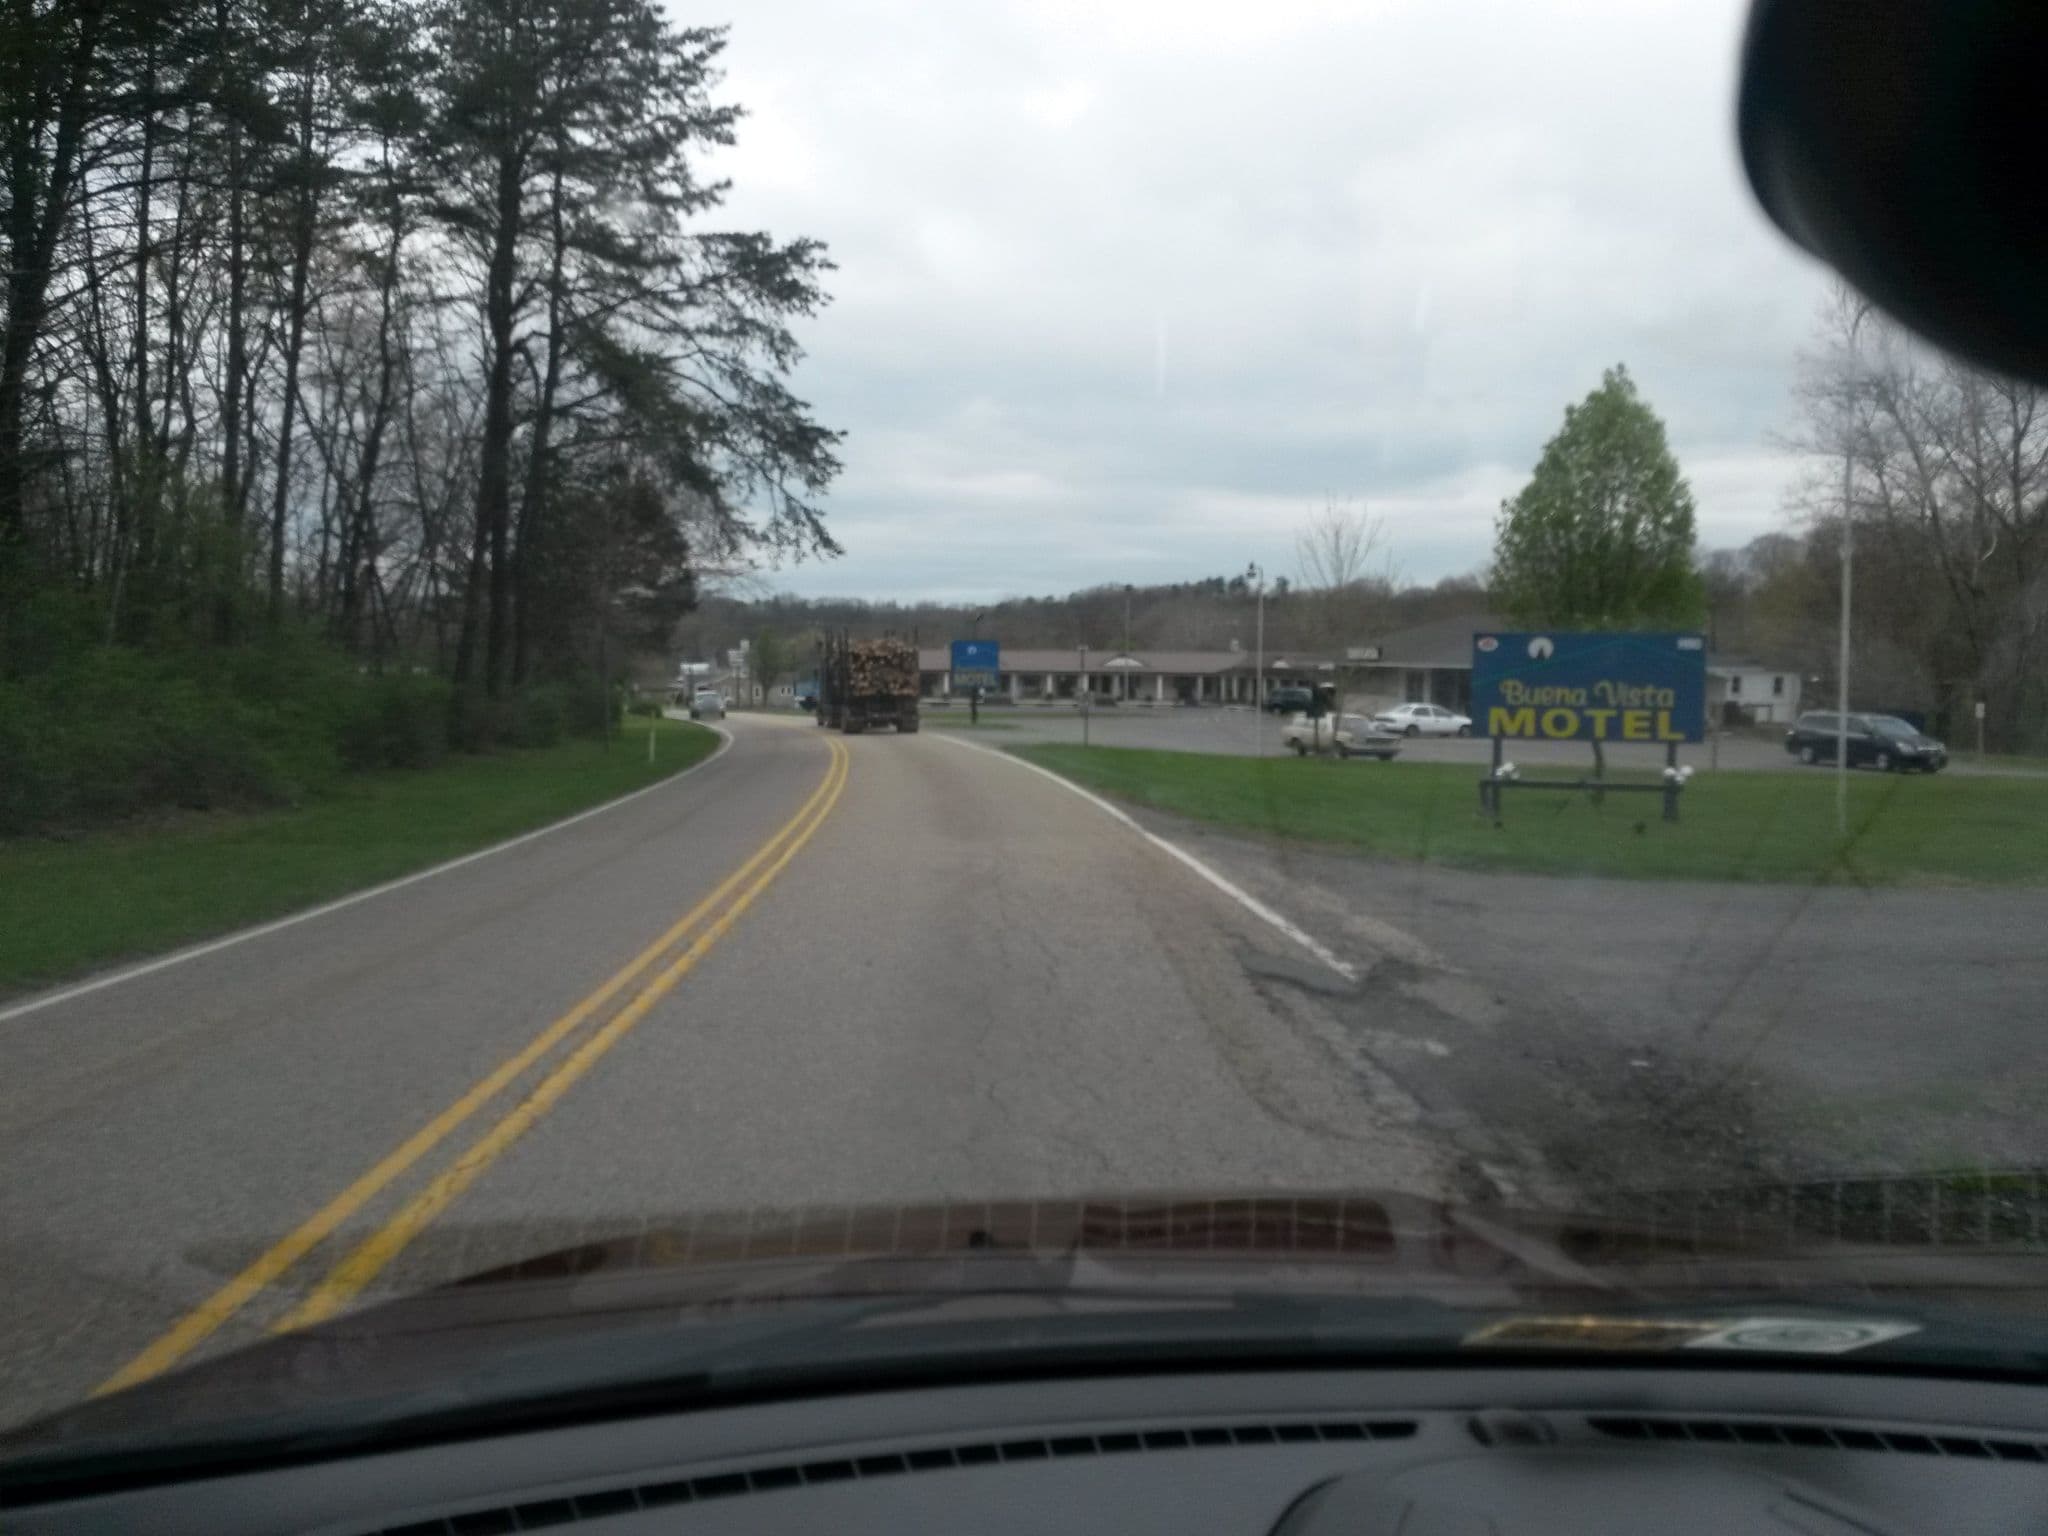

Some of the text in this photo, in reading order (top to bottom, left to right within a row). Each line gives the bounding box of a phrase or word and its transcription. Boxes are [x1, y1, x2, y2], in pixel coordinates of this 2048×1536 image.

[1500, 680, 1674, 707] Buena Vista
[1489, 708, 1684, 740] MOTEL
